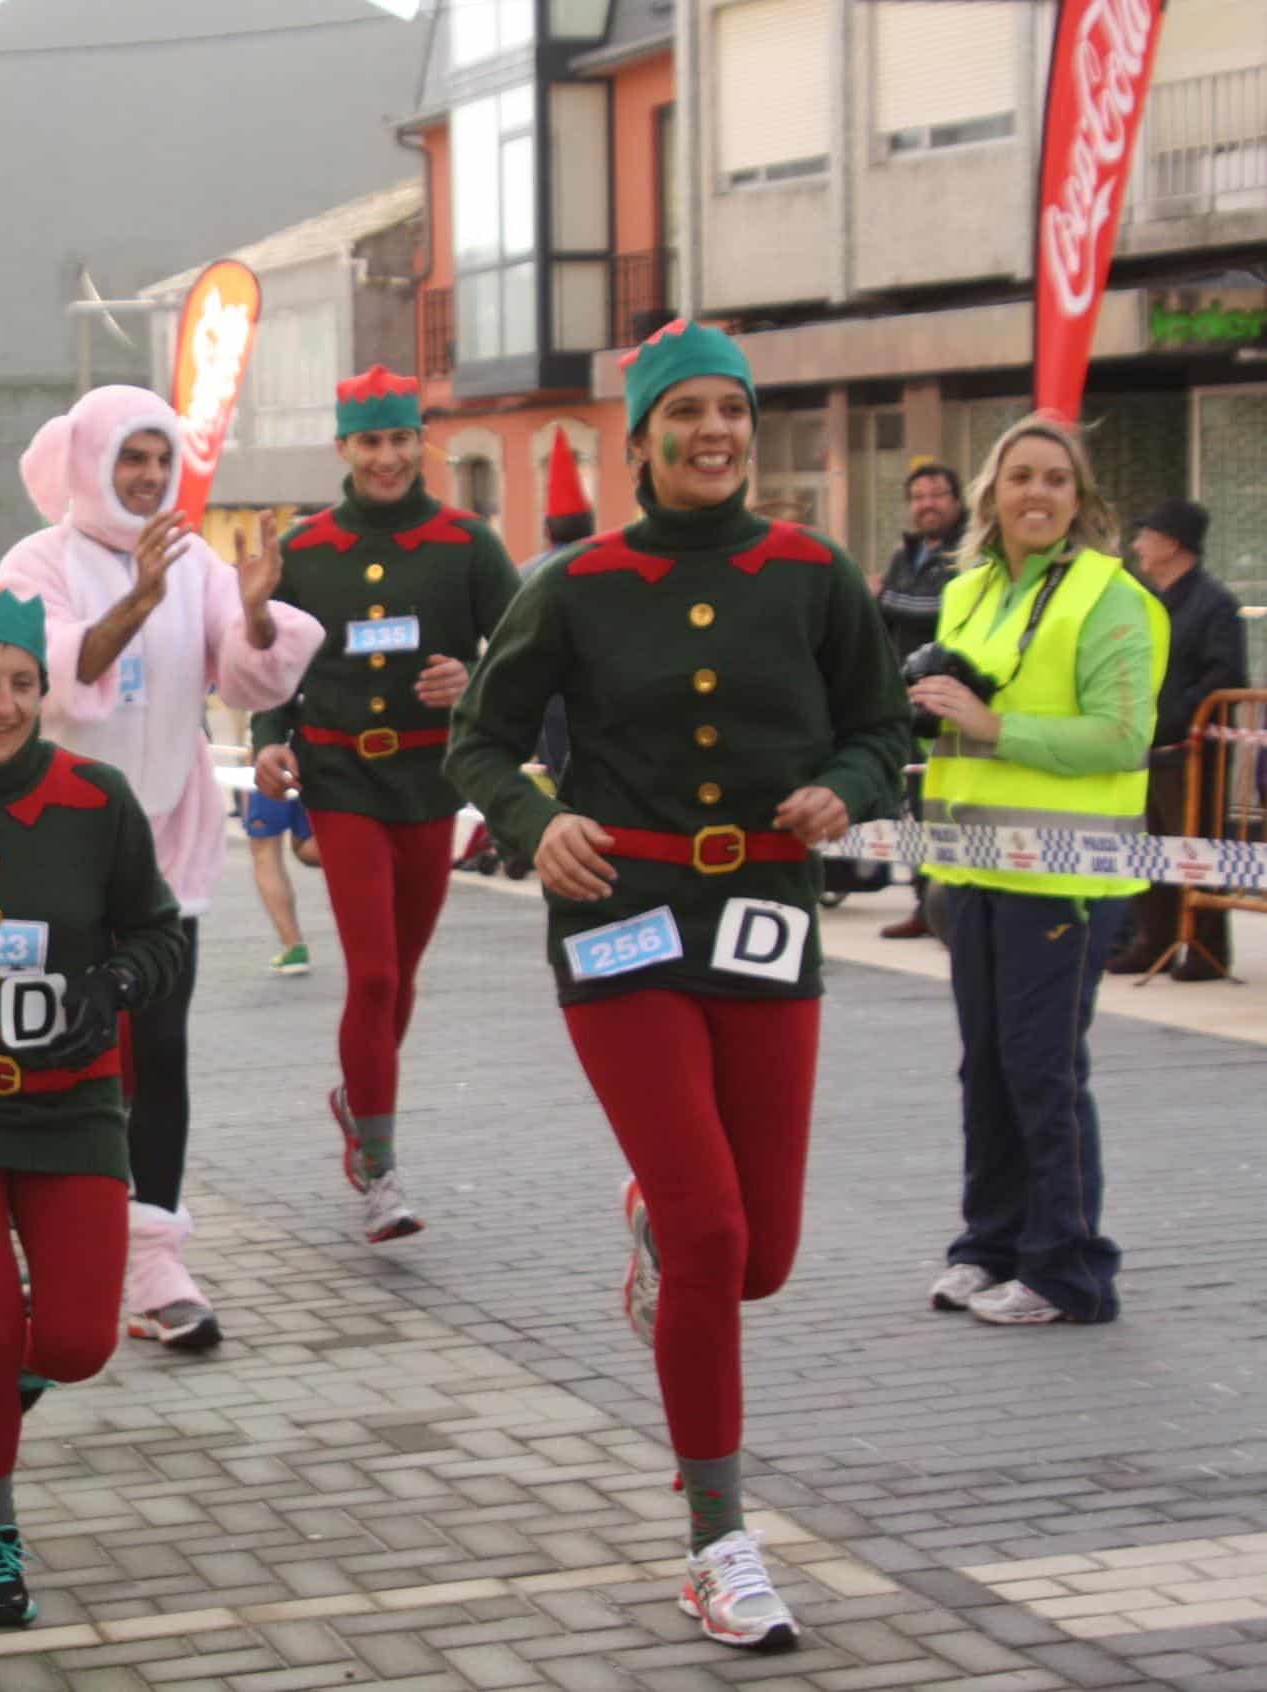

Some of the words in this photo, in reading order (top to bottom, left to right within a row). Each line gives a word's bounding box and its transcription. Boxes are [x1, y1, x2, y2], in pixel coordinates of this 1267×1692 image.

[590, 926, 662, 971] 256
[733, 906, 789, 964] D
[13, 981, 57, 1041] D
